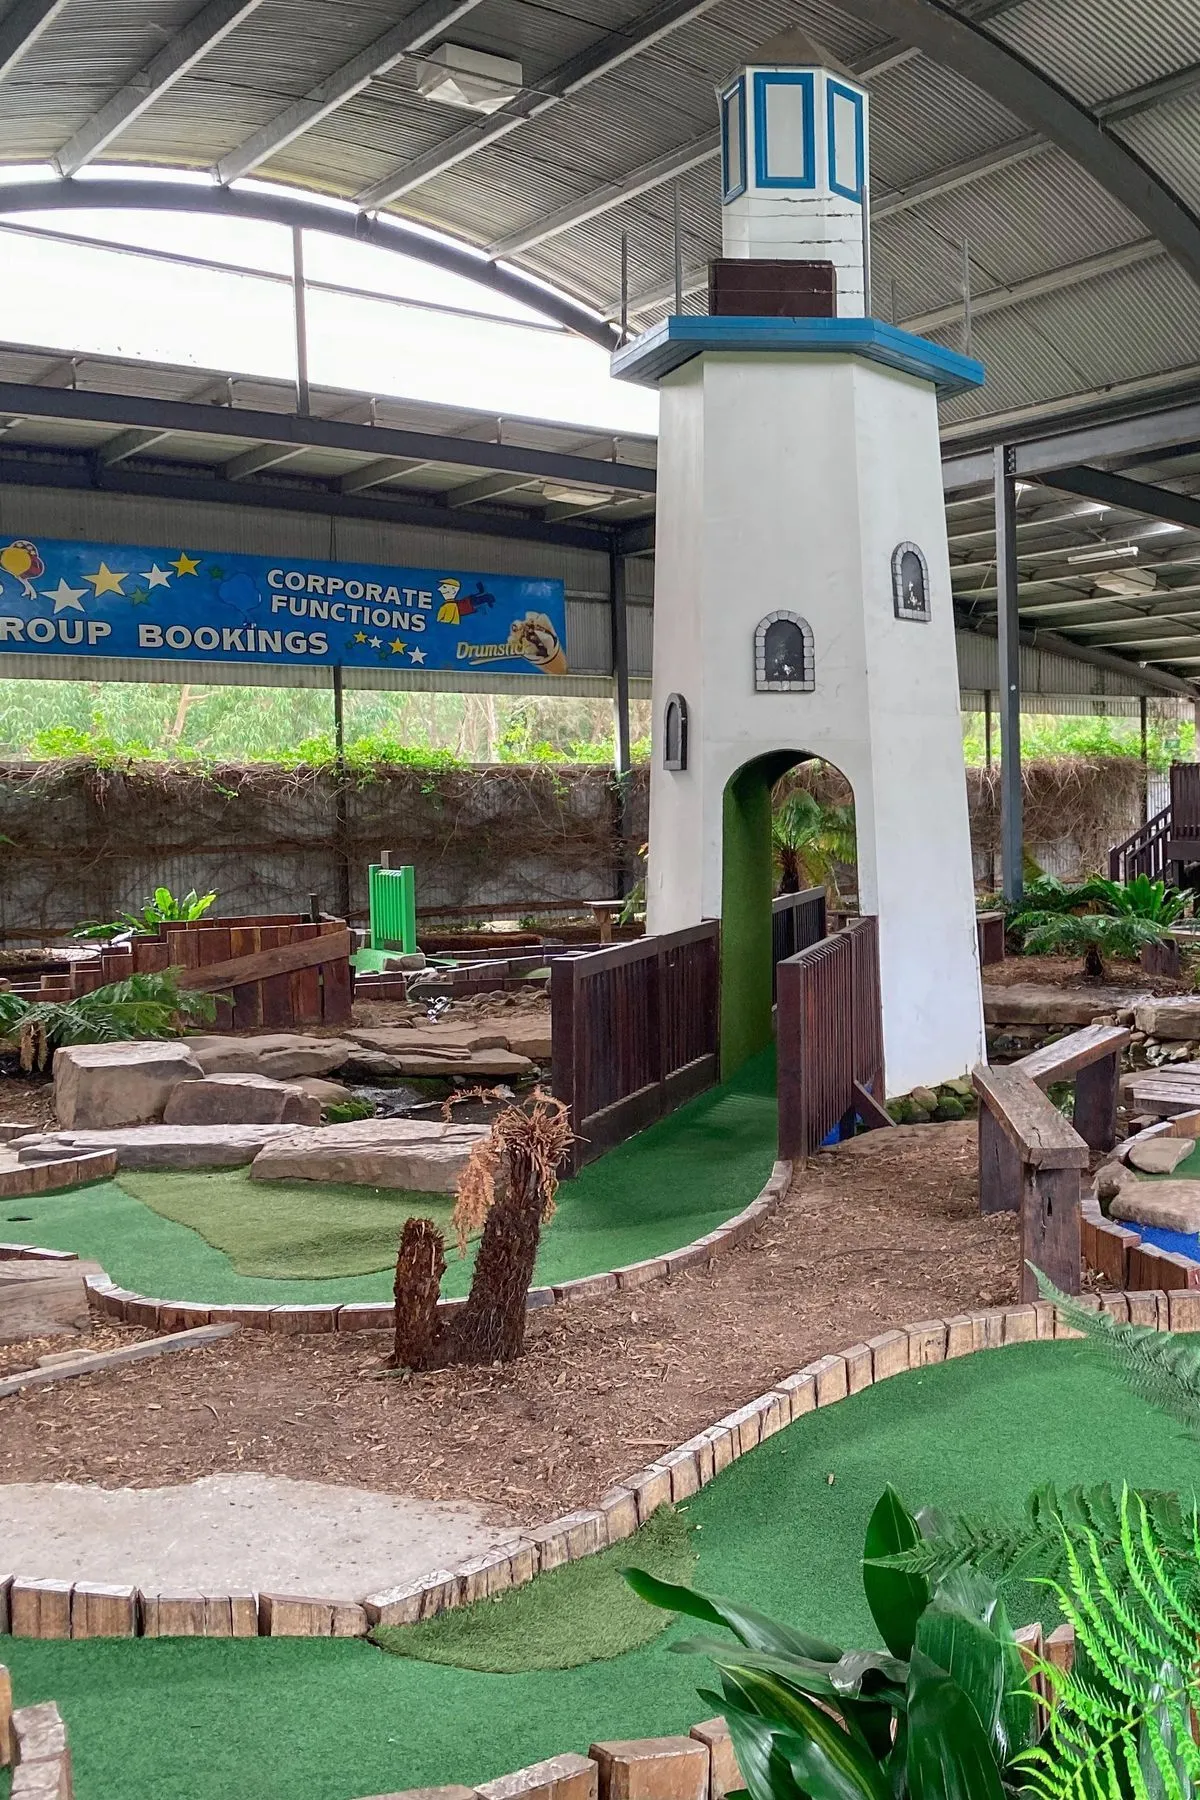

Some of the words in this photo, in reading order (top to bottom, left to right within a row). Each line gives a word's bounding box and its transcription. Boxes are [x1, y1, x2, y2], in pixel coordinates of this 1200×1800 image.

[267, 569, 433, 610] CORPORATE
[271, 594, 426, 633] FUNCTIONS
[138, 624, 329, 655] BOOKINGS
